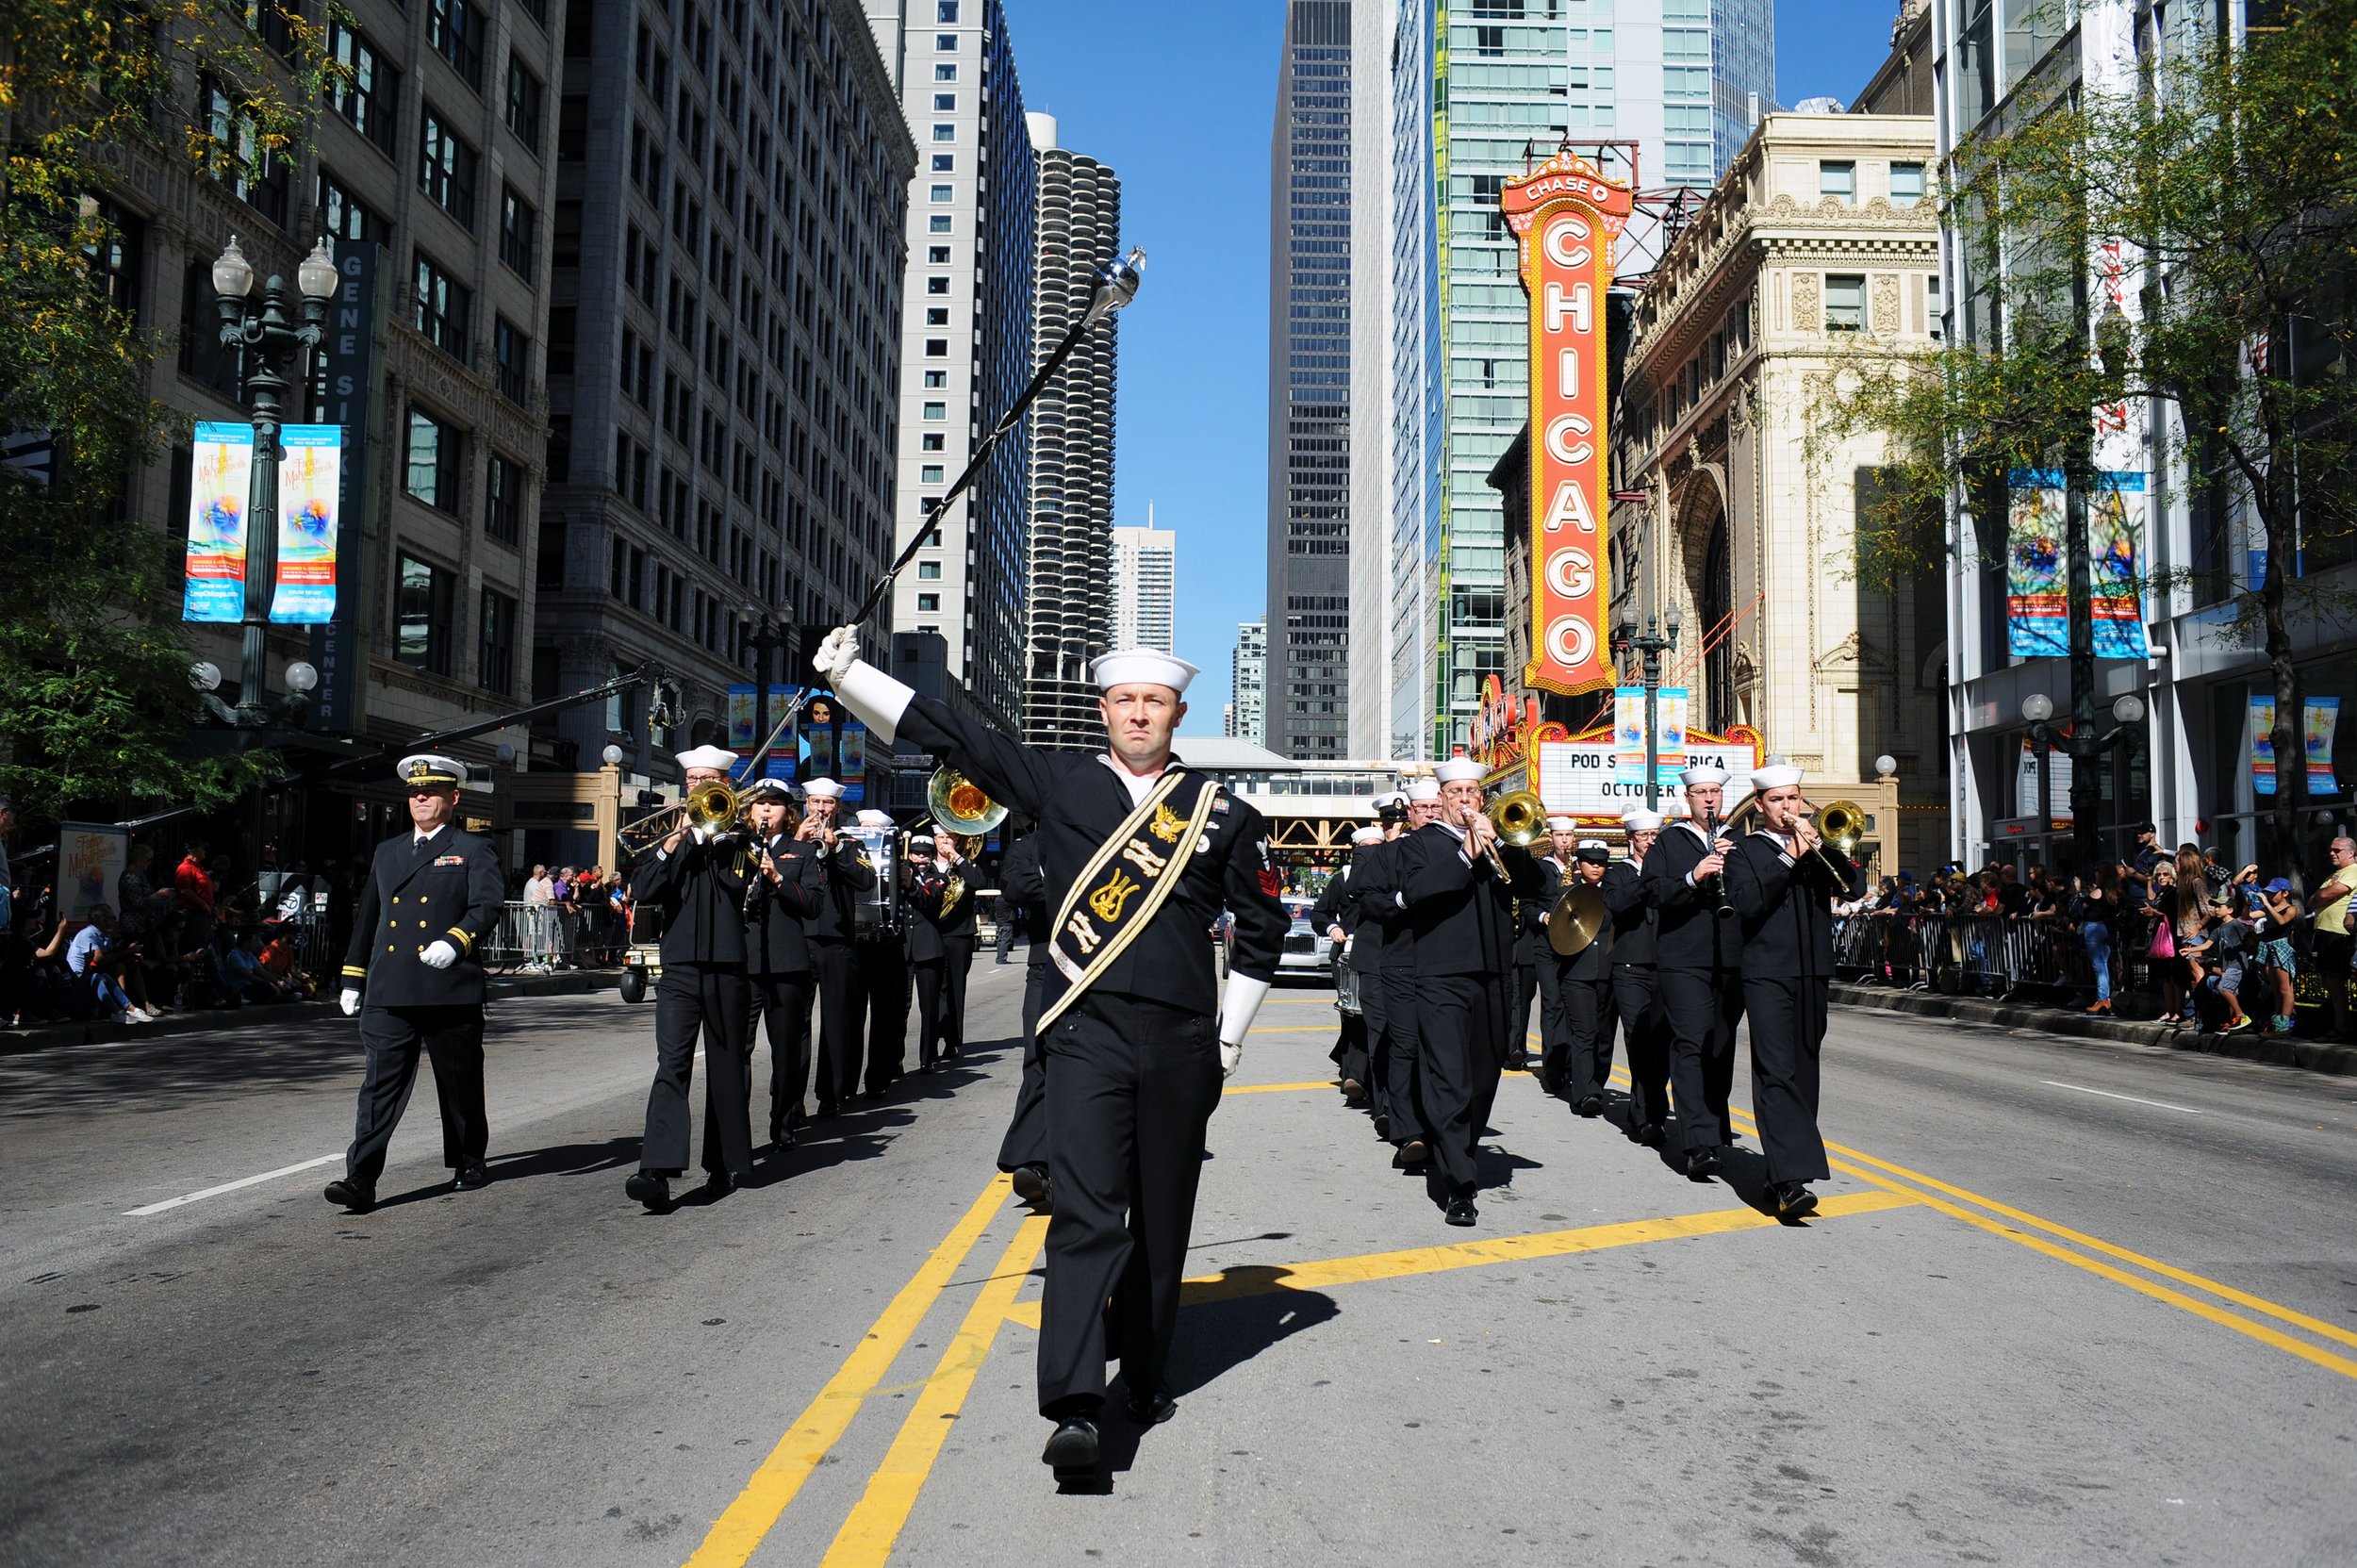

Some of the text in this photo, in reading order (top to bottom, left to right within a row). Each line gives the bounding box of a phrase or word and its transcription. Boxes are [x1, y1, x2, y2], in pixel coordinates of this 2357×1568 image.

[1525, 177, 1591, 201] CHASE
[336, 256, 362, 529] GENE SISKE
[1542, 218, 1597, 668] CHICAGO
[321, 623, 337, 718] CENTER
[1571, 753, 1600, 768] POD
[1684, 755, 1725, 769] RICA
[1602, 782, 1675, 798] OCTOER
